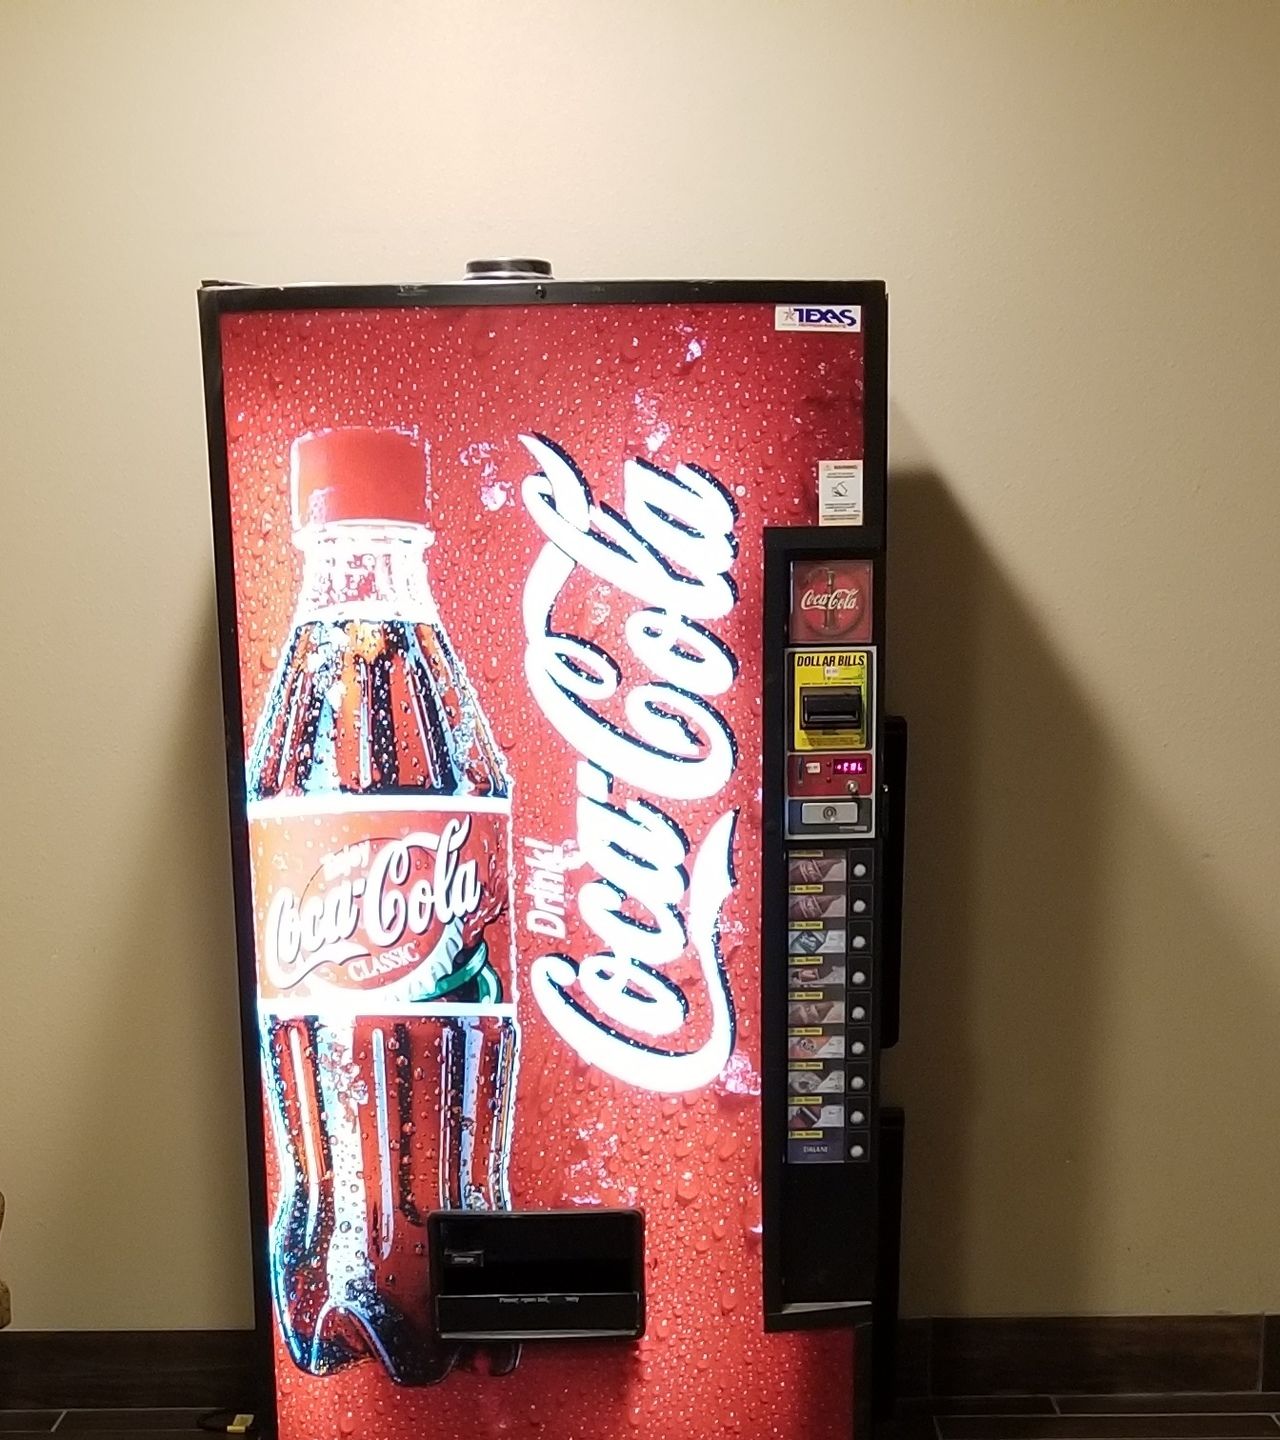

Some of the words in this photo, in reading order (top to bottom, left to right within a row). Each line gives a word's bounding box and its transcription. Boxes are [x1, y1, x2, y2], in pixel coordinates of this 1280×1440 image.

[793, 308, 857, 326] TEXAS
[801, 588, 860, 610] Coca-Cola
[797, 655, 835, 667] DOLLAR
[837, 655, 865, 667] BILLS
[521, 432, 739, 1092] Coca-Cola
[265, 814, 481, 989] Coca-Cola
[348, 941, 420, 982] CLASSIC
